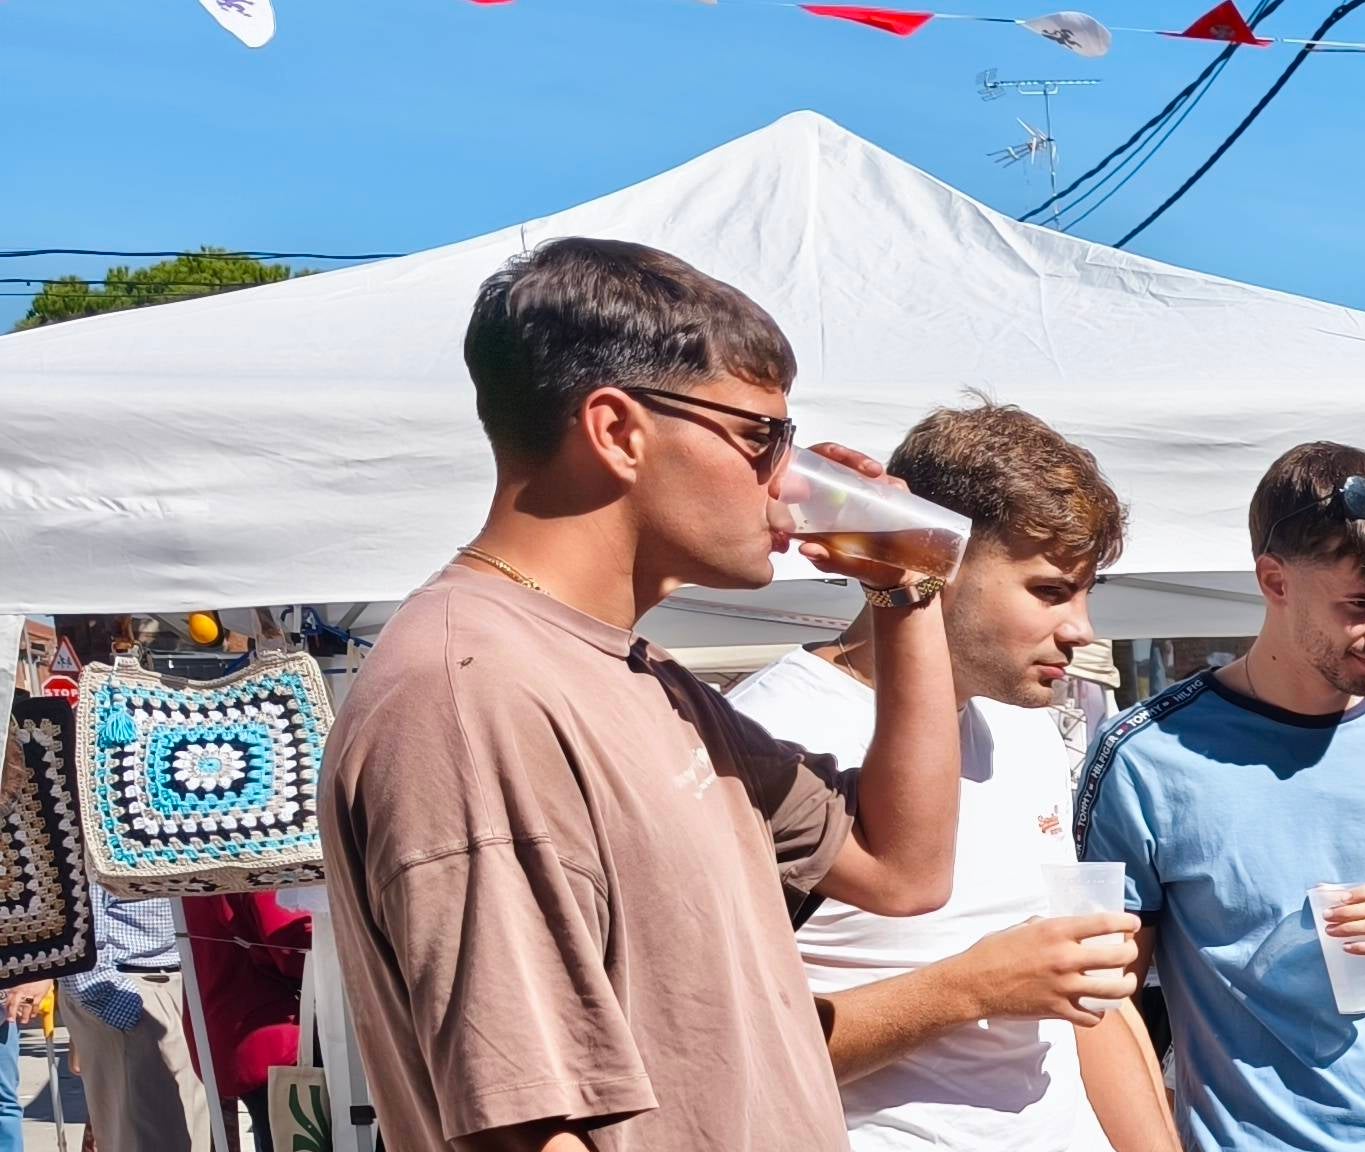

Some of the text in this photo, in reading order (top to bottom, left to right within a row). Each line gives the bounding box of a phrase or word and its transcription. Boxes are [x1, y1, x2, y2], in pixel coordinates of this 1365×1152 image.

[44, 688, 78, 698] STOP
[1078, 792, 1094, 828] TOMMY
[1091, 735, 1119, 780] HILFIGER
[1127, 703, 1162, 729] TOMMY
